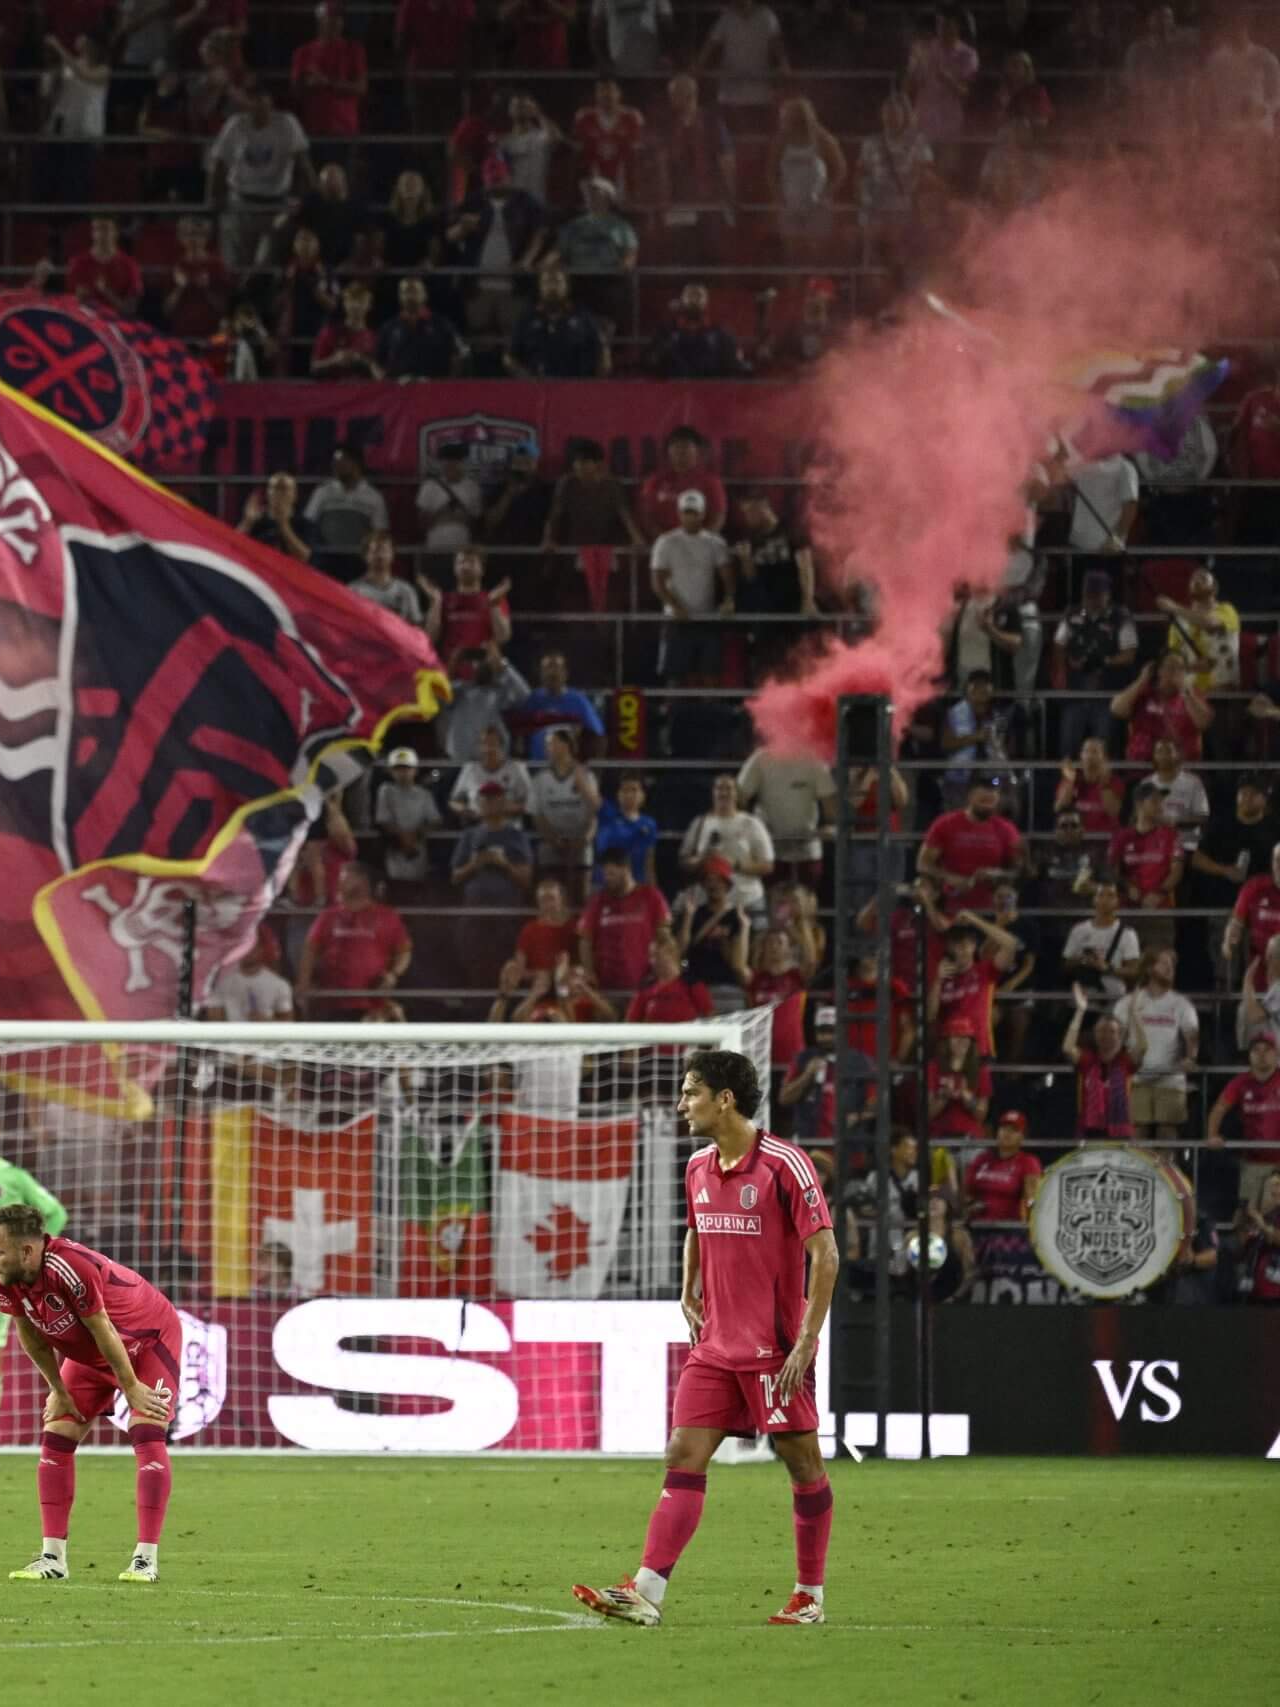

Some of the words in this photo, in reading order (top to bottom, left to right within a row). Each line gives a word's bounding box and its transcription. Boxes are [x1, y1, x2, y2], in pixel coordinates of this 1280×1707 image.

[1081, 1189, 1131, 1203] FLEUR
[705, 1214, 758, 1233] PURINA
[1095, 1211, 1117, 1225] DE
[1081, 1232, 1132, 1249] NOISE
[1090, 1360, 1182, 1423] VS
